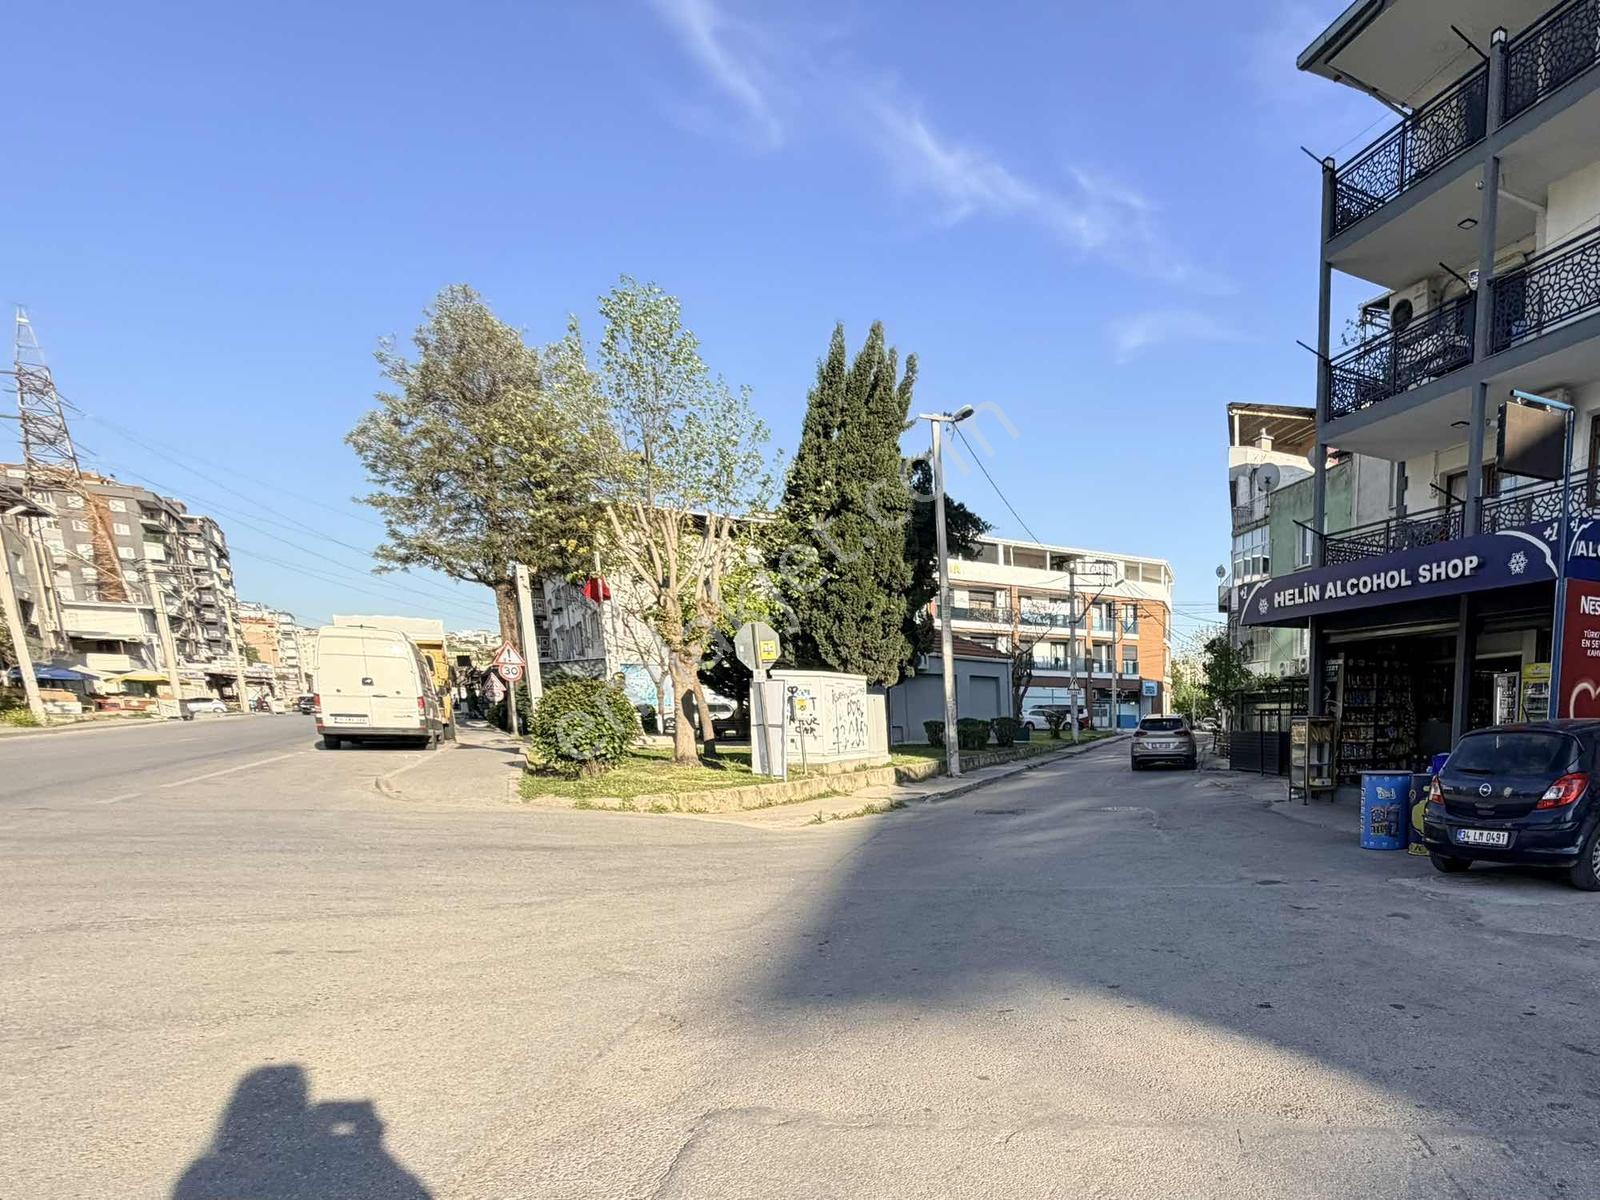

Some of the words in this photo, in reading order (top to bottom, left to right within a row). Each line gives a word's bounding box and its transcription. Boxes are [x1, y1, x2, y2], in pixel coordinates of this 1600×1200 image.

[1543, 522, 1559, 541] +1
[1570, 518, 1579, 532] +1
[1274, 582, 1320, 608] HELİN
[1324, 567, 1412, 600] ALCOHOL
[1418, 555, 1479, 583] SHOP
[1581, 639, 1591, 648] EN
[504, 667, 518, 676] 30
[1473, 831, 1484, 842] LM
[1486, 832, 1505, 844] 0491
